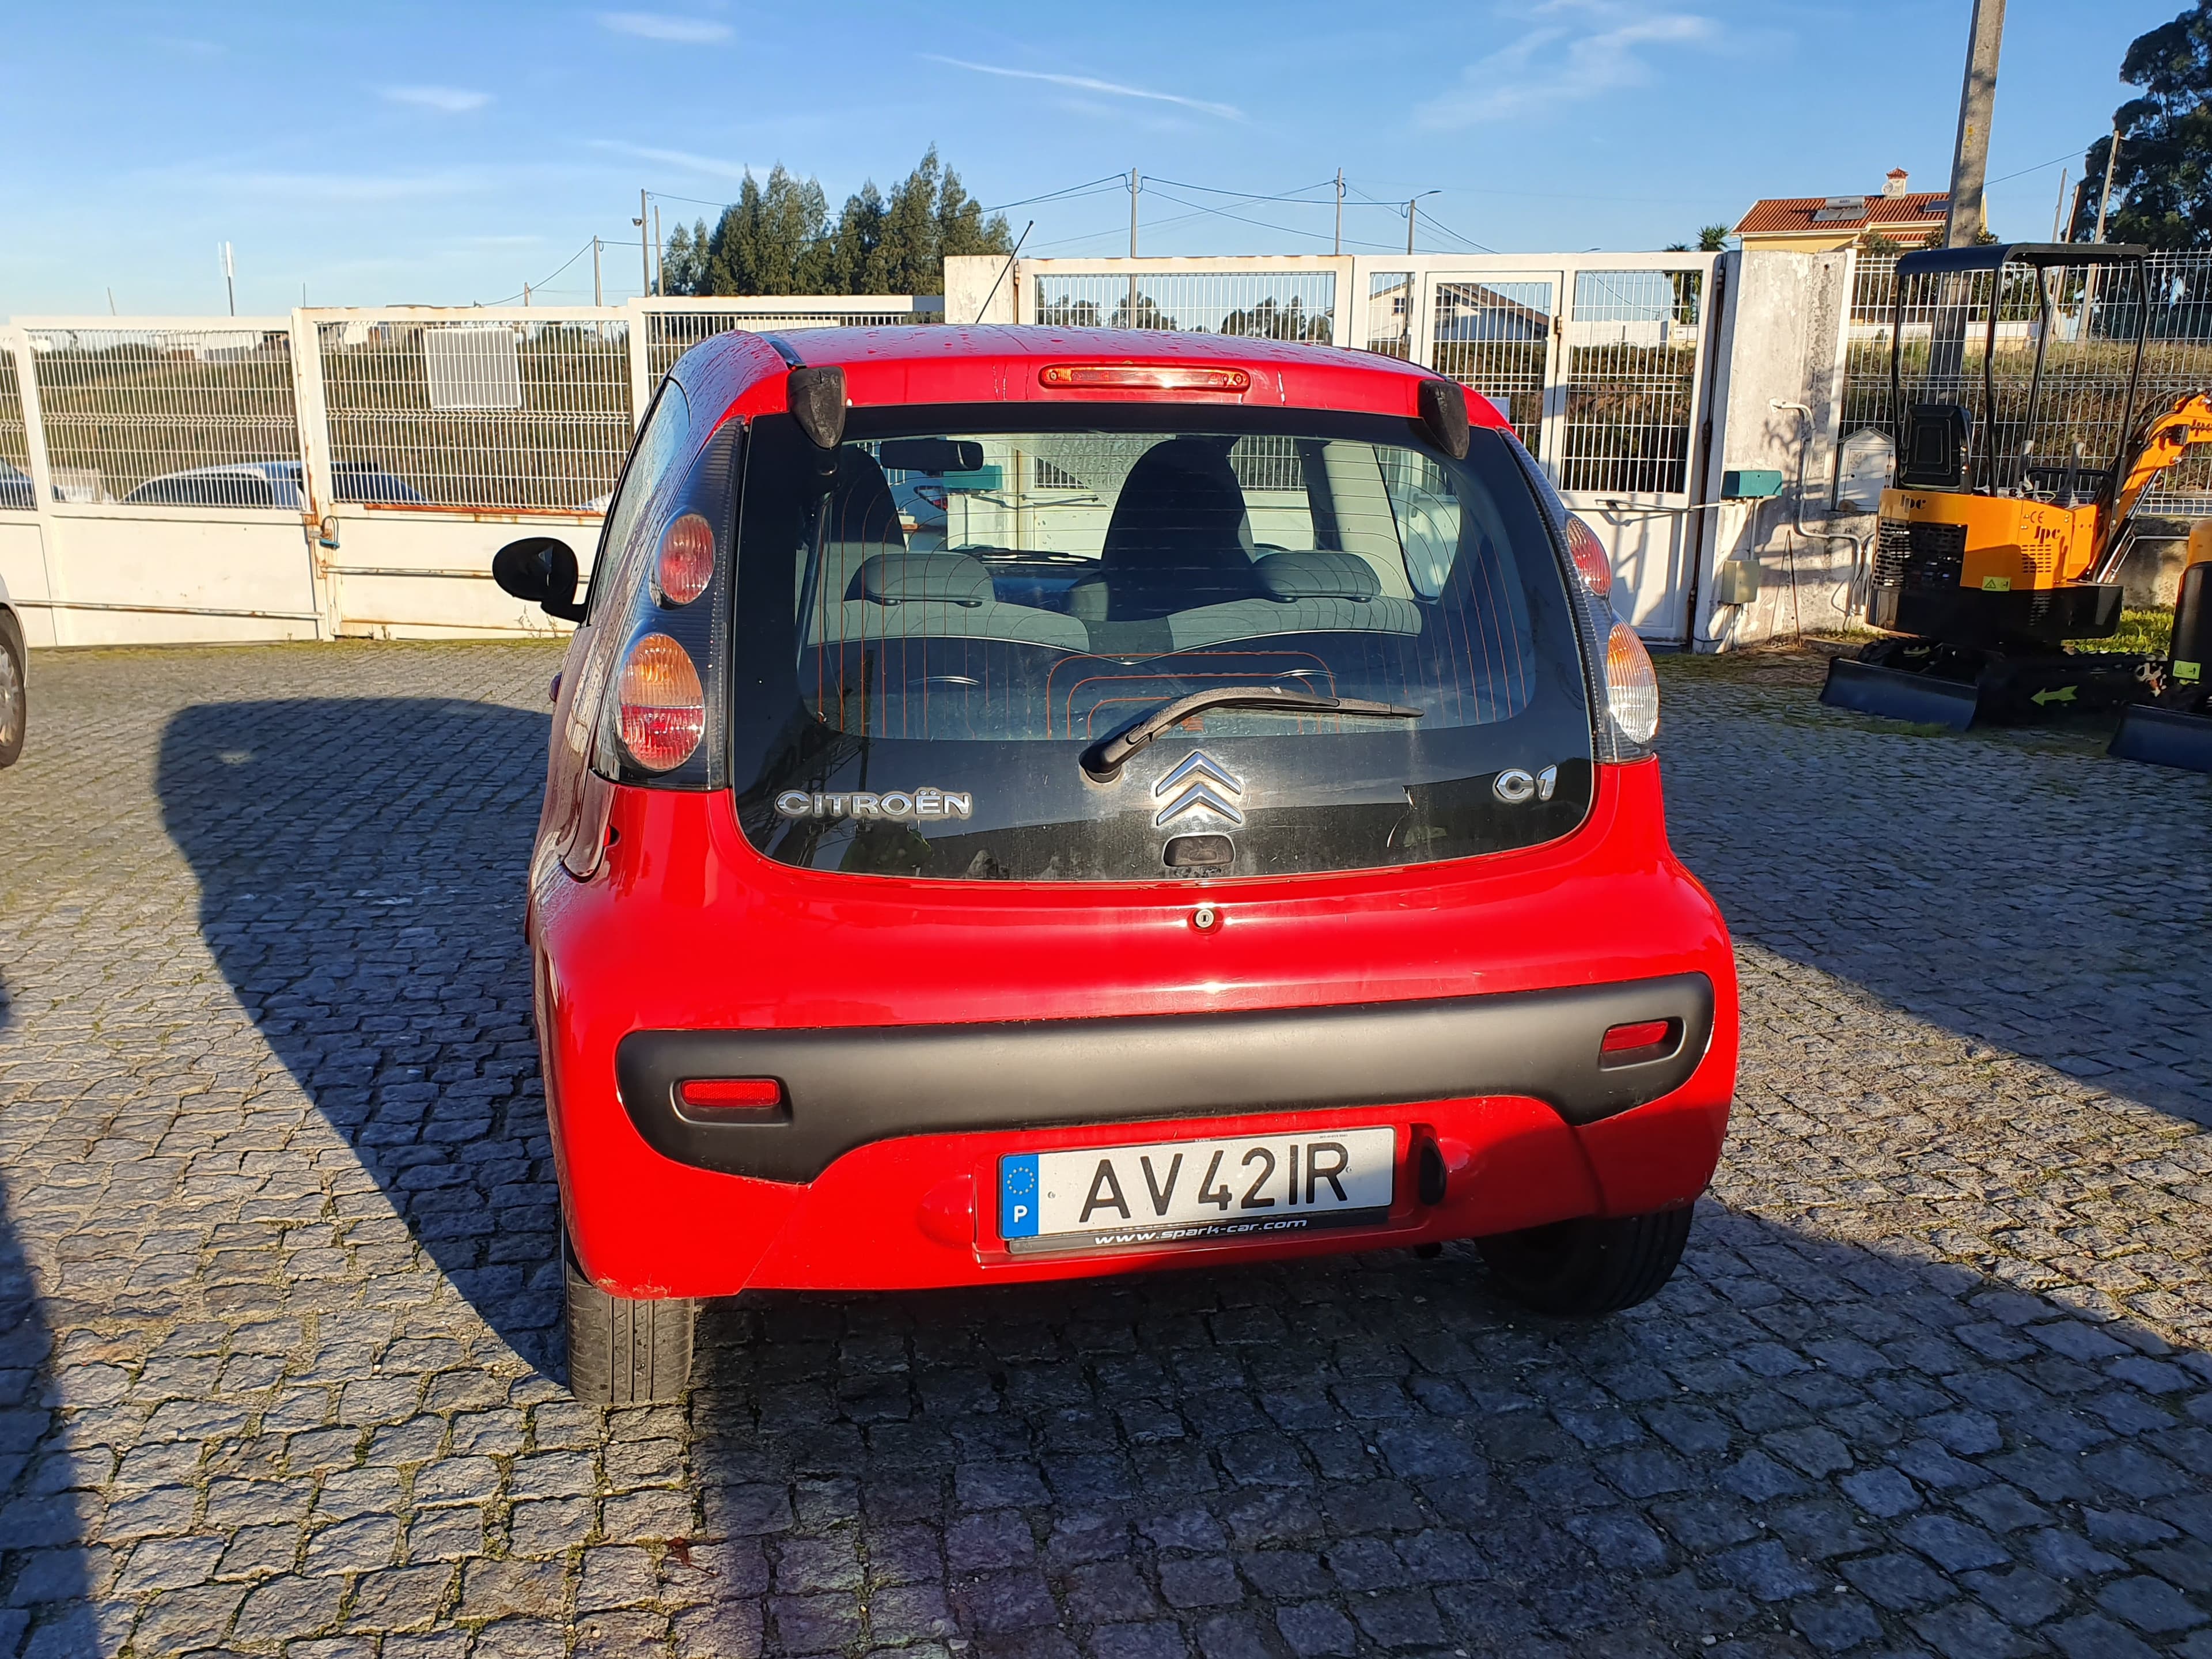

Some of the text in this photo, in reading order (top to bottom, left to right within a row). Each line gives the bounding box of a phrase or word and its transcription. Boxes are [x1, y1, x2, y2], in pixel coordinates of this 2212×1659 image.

[2031, 511, 2044, 523] CE
[1497, 764, 1557, 800] C1
[777, 790, 970, 816] CITROËN
[1014, 1205, 1028, 1223] P
[1094, 1218, 1308, 1245] www.spark-car.com
